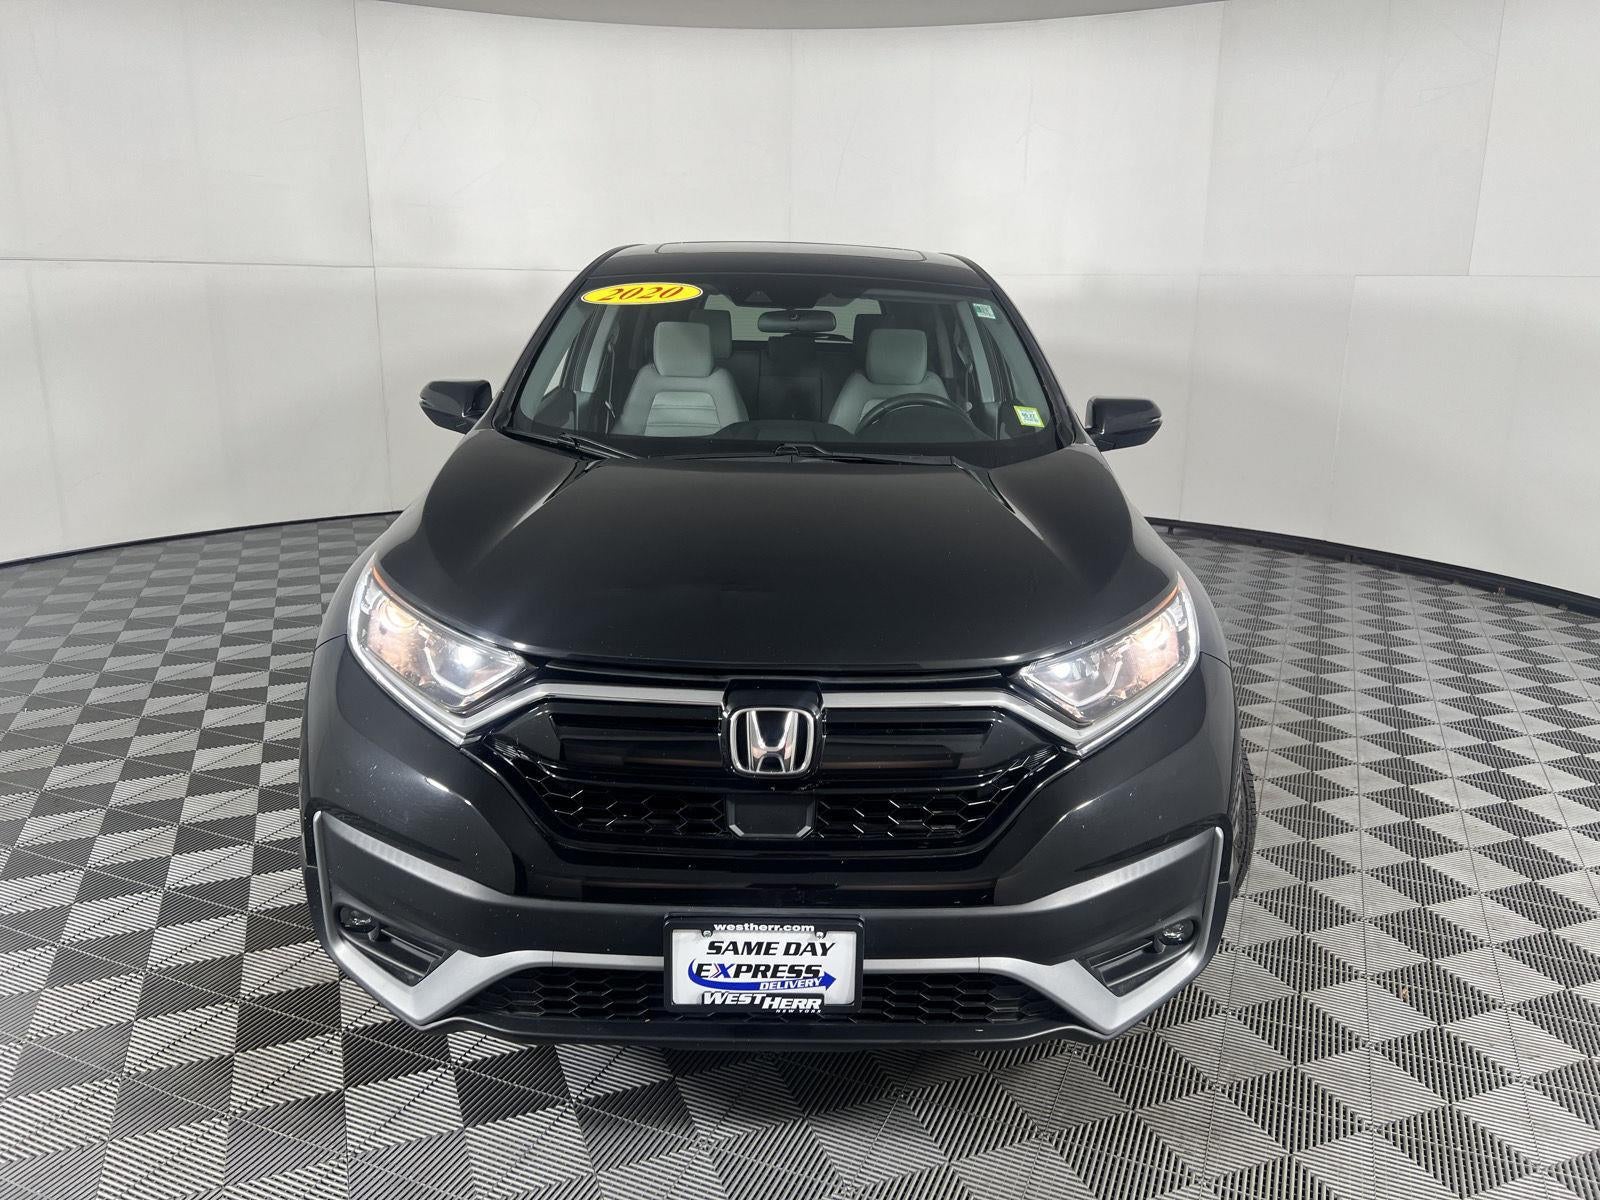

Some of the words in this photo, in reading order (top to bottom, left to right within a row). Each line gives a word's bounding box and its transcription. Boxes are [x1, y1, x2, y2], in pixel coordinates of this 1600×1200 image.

[598, 286, 684, 301] 2020
[714, 923, 815, 932] westherr.com
[706, 941, 779, 956] SAME
[783, 942, 836, 957] DAY
[695, 963, 823, 979] EXPRESS
[759, 978, 823, 990] DELIVERY
